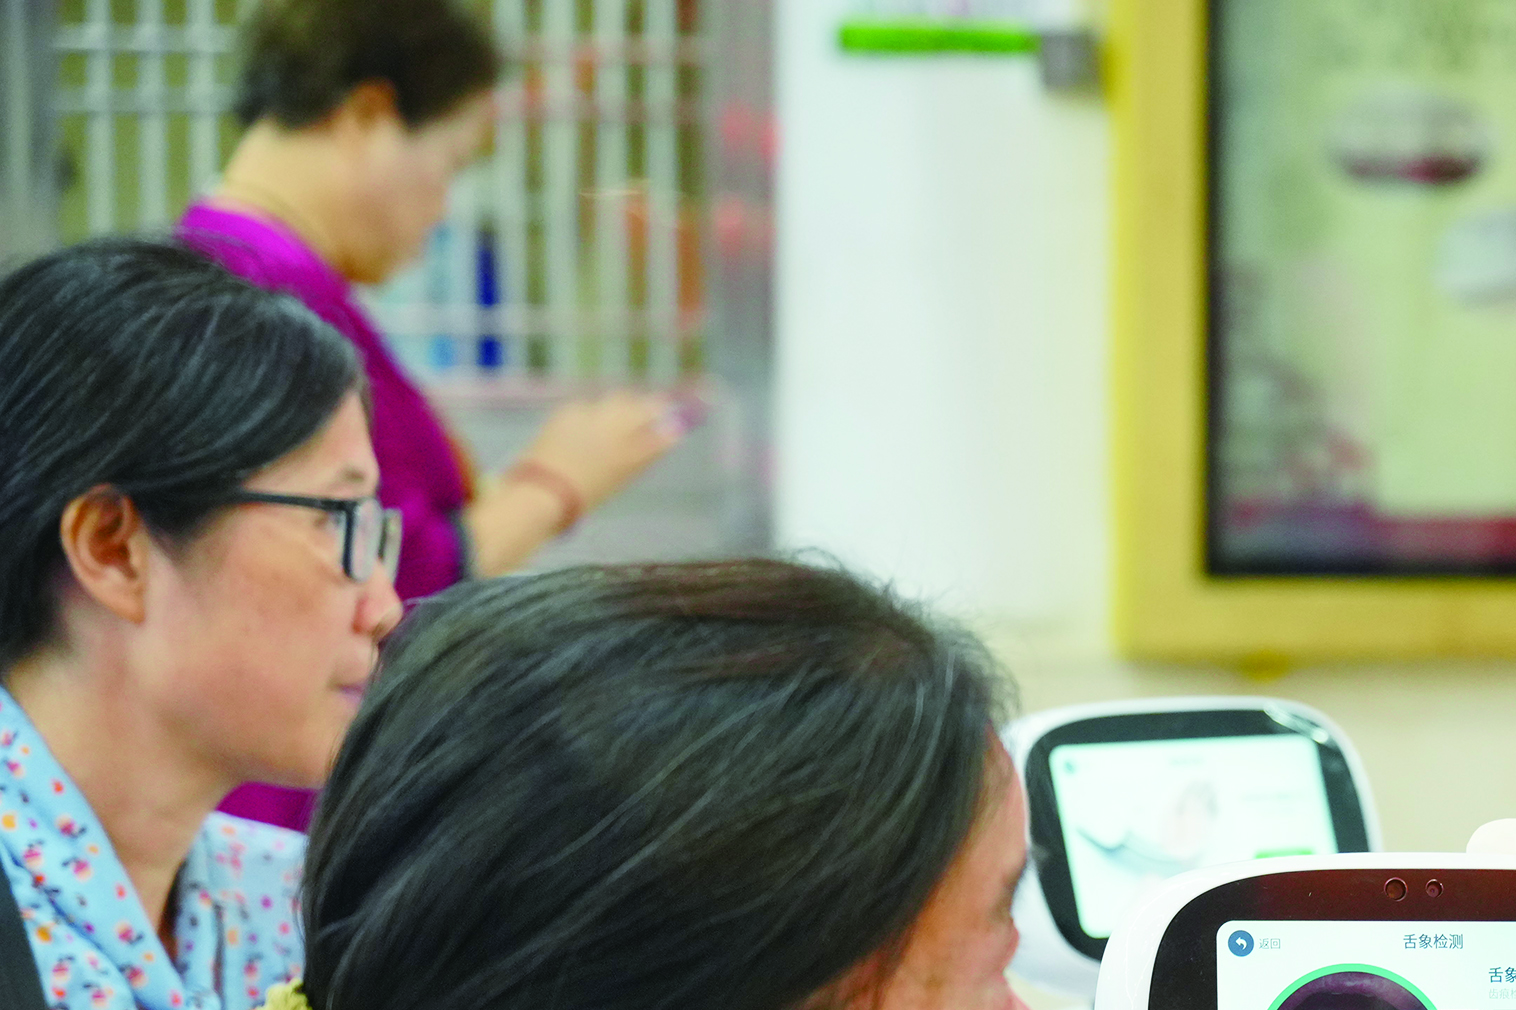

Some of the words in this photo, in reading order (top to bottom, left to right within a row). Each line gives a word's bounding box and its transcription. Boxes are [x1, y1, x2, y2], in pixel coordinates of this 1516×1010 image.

[1258, 937, 1281, 949] 返回
[1403, 933, 1464, 949] 舌象检测
